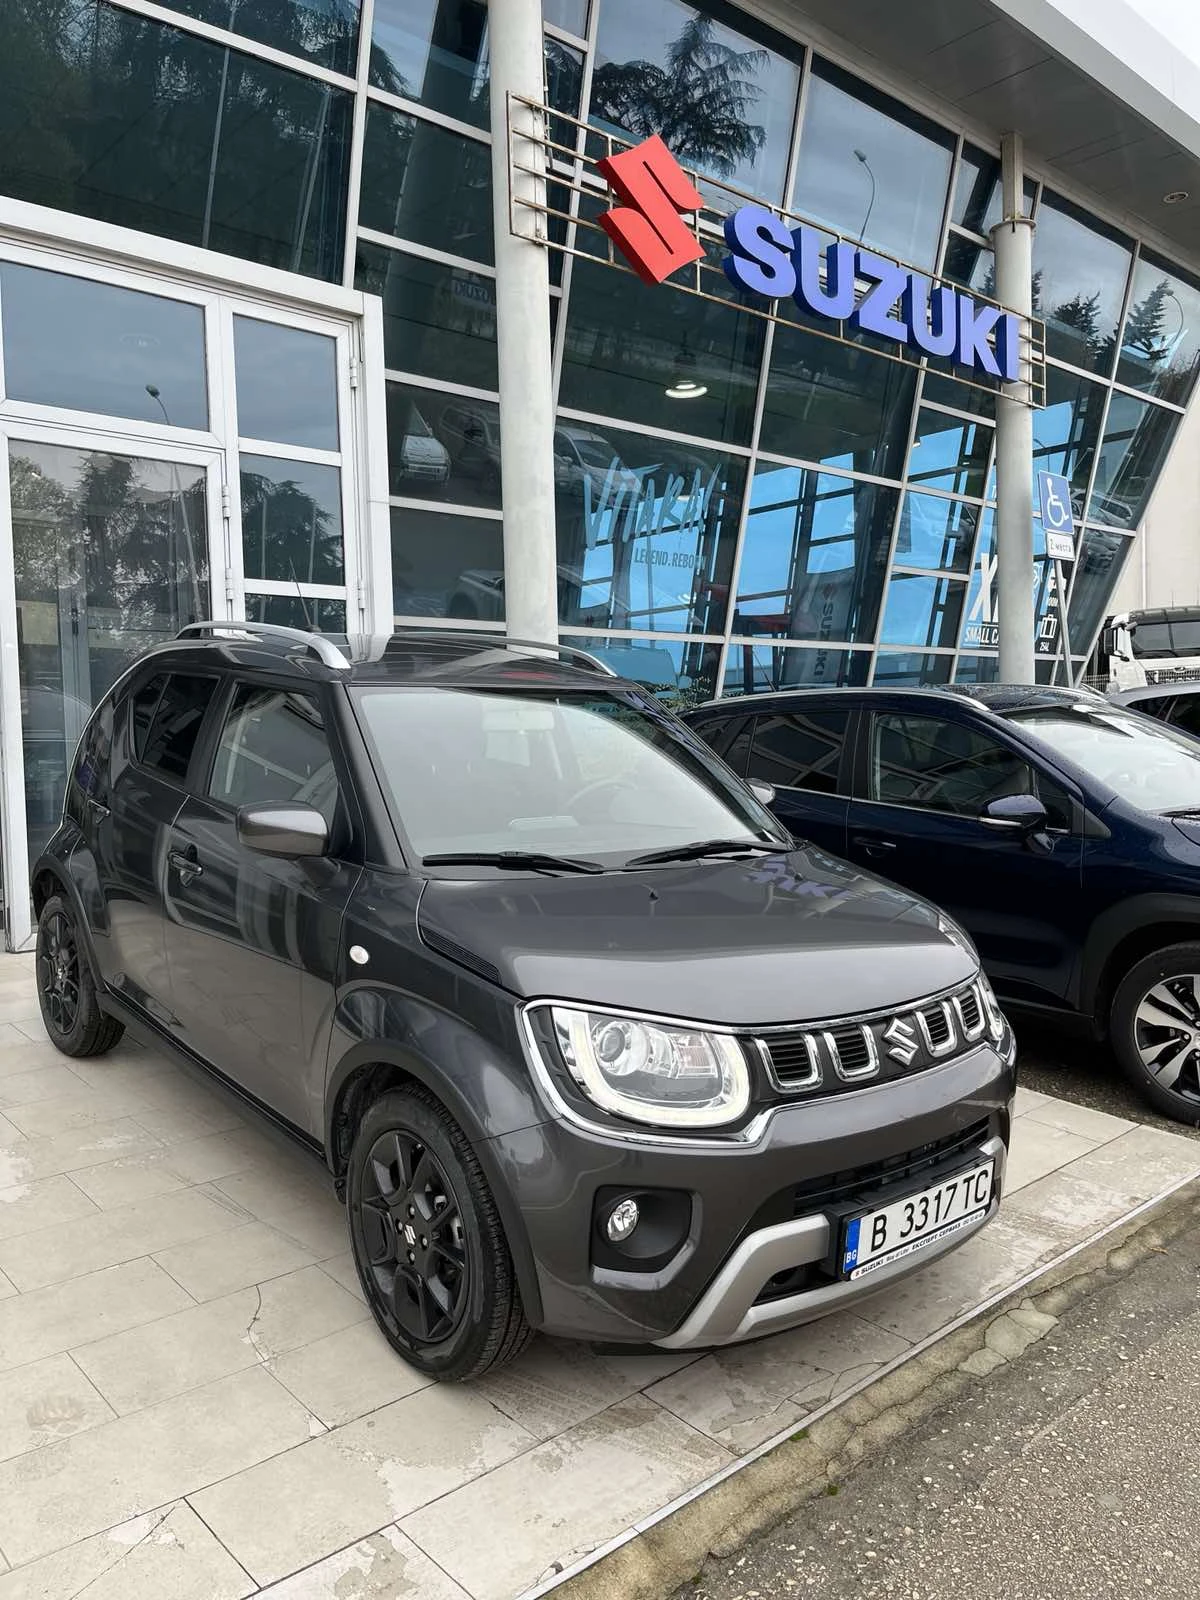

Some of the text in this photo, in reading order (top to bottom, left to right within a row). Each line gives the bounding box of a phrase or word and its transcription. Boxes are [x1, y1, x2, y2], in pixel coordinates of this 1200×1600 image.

[723, 206, 1020, 383] SUZUKI
[965, 626, 989, 643] SMALL
[846, 1169, 989, 1264] BG B 3317 TC
